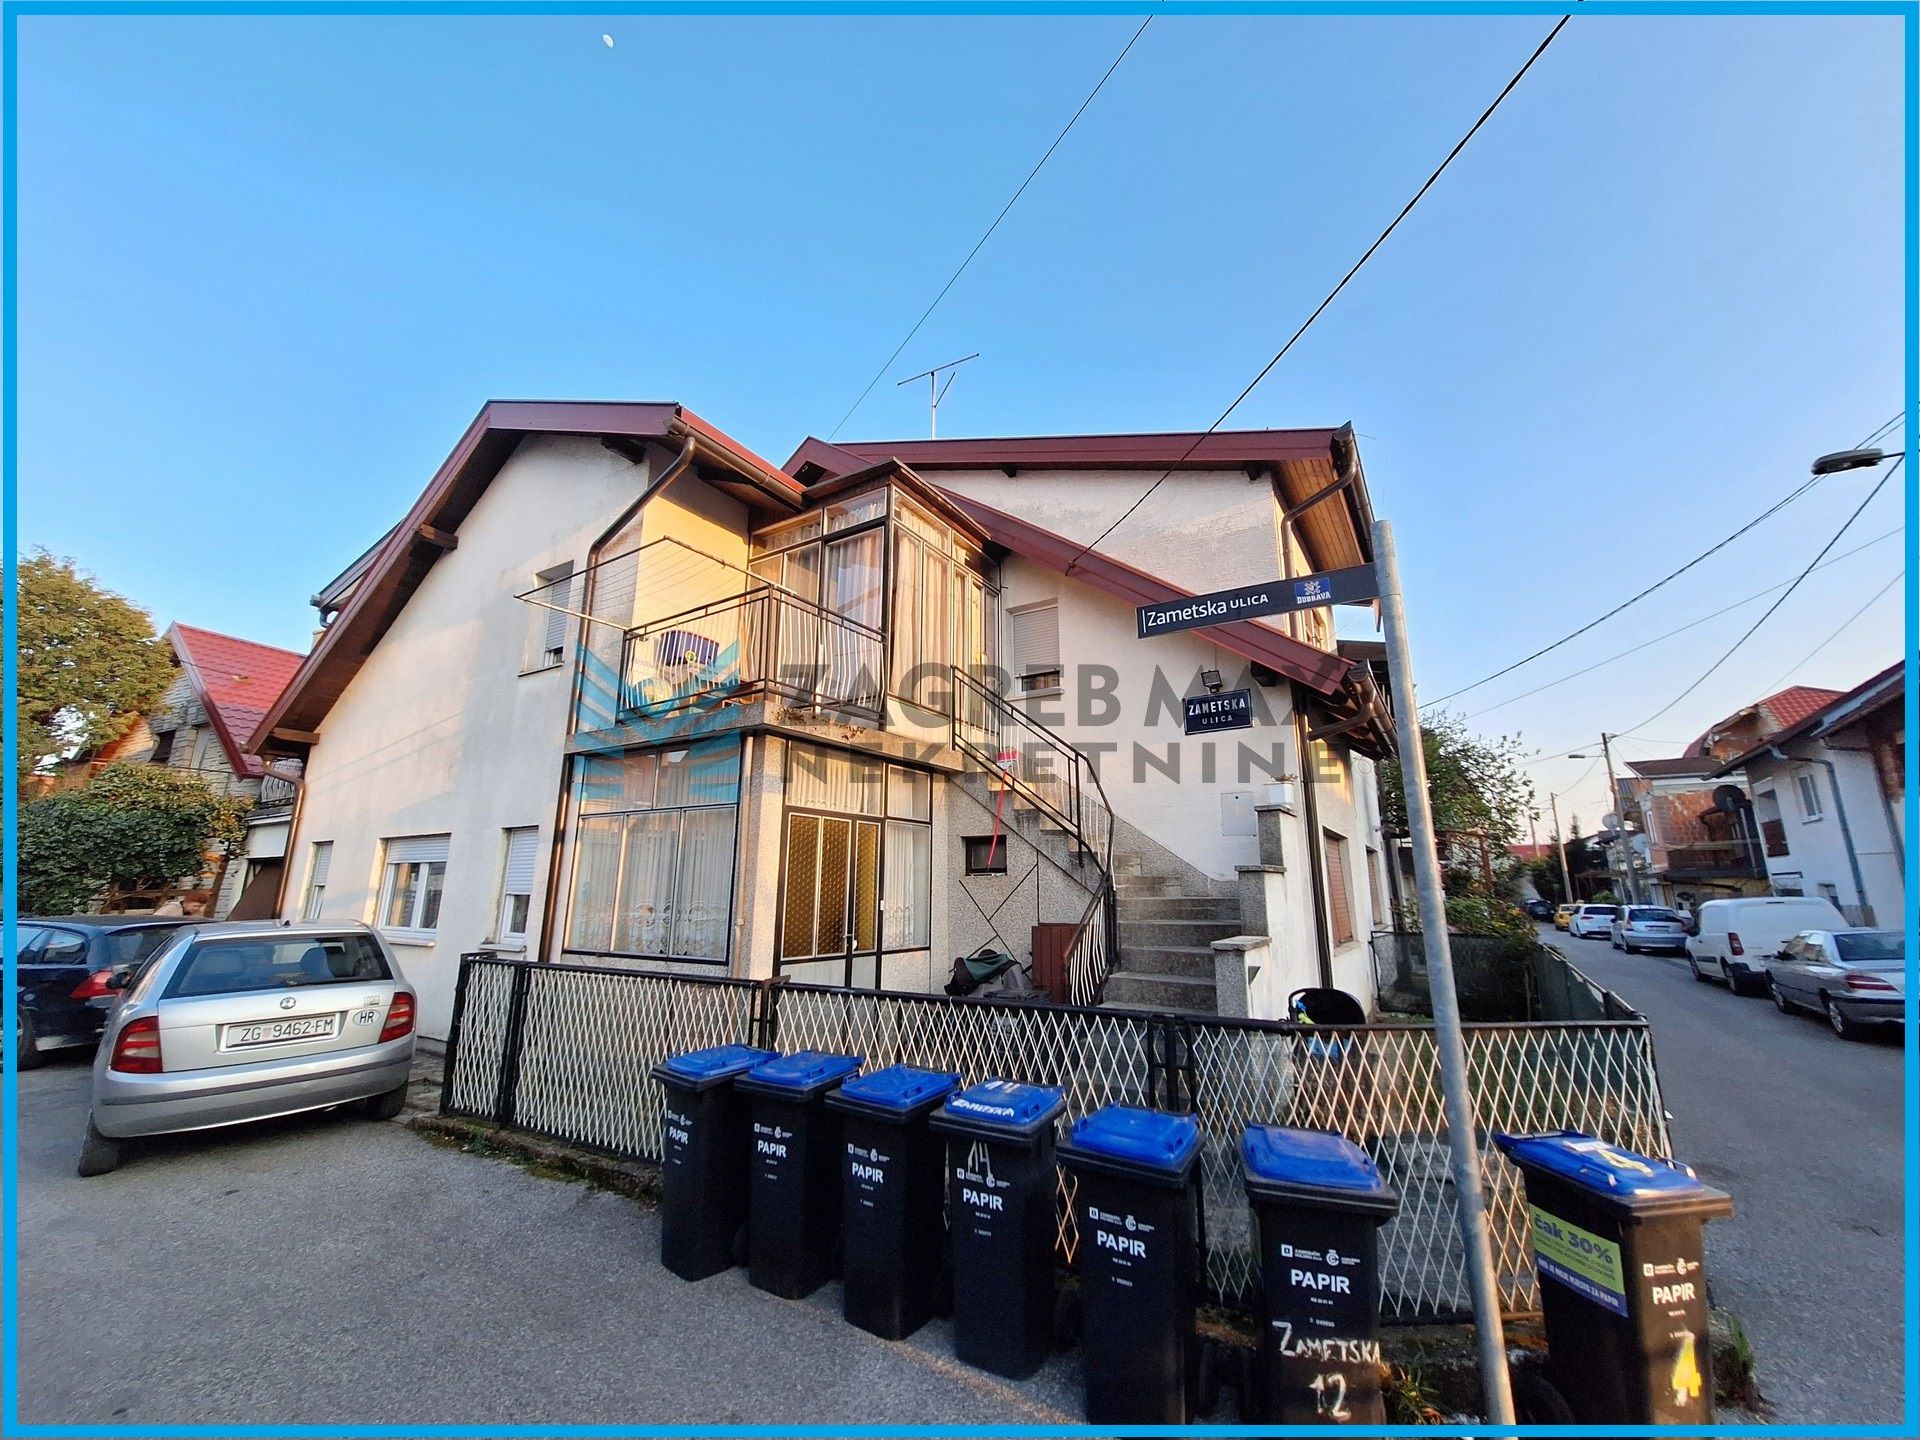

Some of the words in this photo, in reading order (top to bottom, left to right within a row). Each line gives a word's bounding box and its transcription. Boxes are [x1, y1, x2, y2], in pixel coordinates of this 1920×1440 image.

[1296, 591, 1332, 604] DUBRAVA
[1147, 600, 1228, 627] Zametska
[1229, 593, 1269, 609] ULICA
[1188, 697, 1246, 716] ZAMETSKA
[1201, 714, 1233, 725] ULICA
[359, 1011, 375, 1024] HR
[240, 1027, 261, 1042] ZG
[272, 1018, 334, 1039] 9462-FM
[669, 1126, 689, 1145] PAPIR
[757, 1139, 787, 1158] PAPIR
[851, 1161, 884, 1184] PAPIR
[963, 1187, 1004, 1212] PAPIR
[1096, 1229, 1147, 1259] PAPIR
[1567, 1230, 1614, 1264] 30%
[1290, 1268, 1351, 1295] PAPIR
[1652, 1282, 1697, 1305] PAPIR
[1271, 1320, 1381, 1365] ZAMETSKA
[1308, 1373, 1352, 1419] 12
